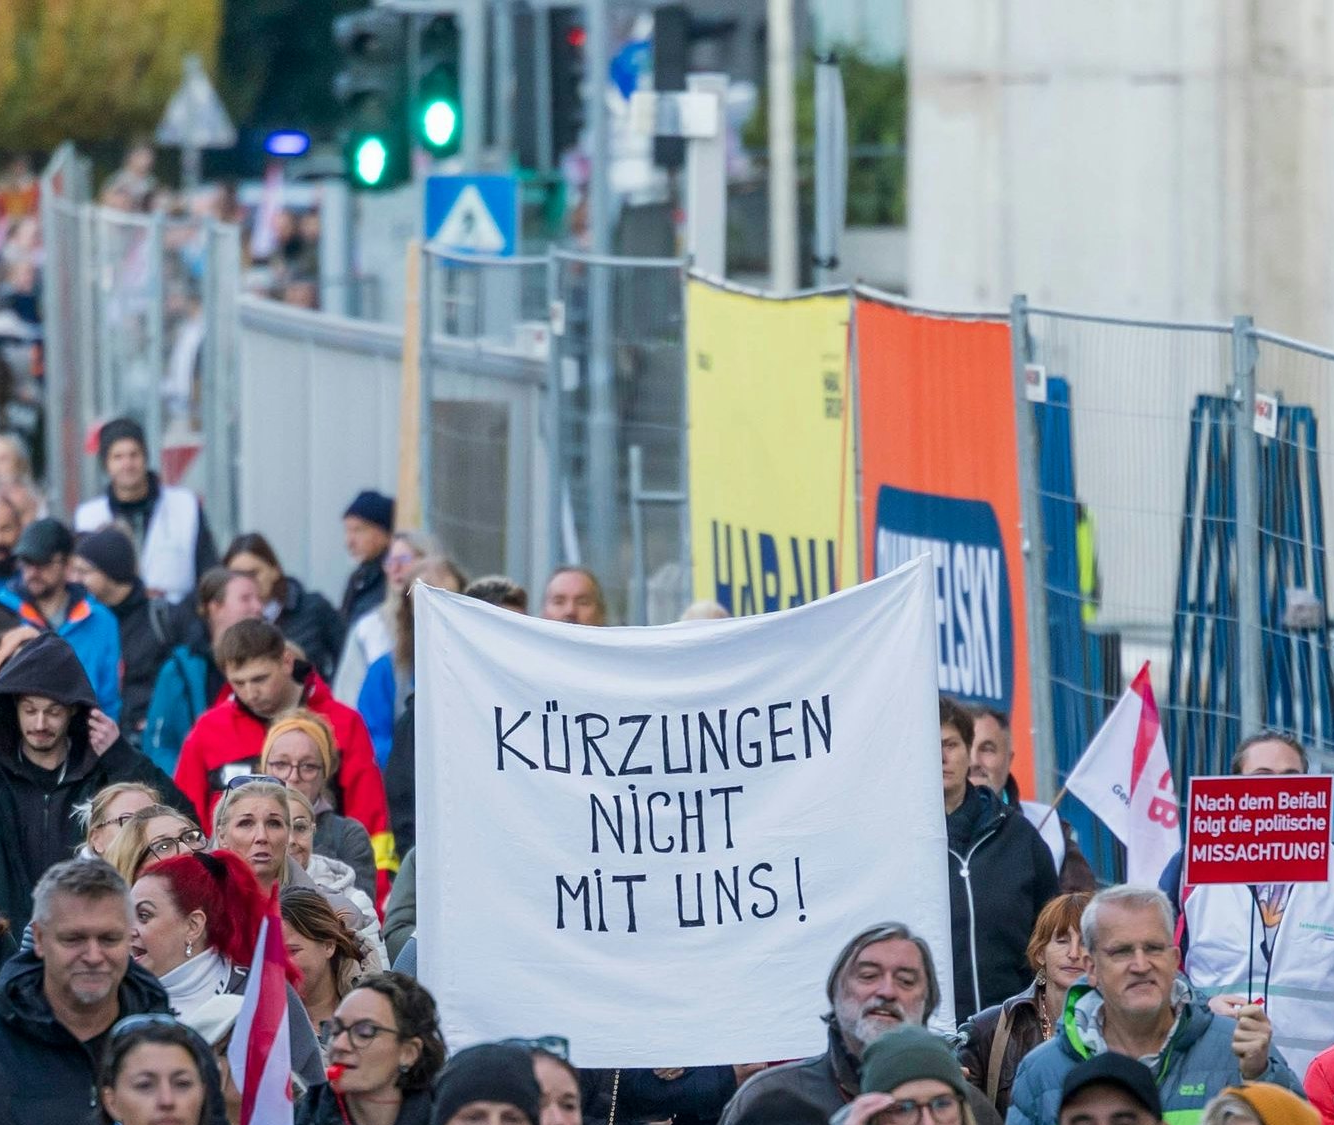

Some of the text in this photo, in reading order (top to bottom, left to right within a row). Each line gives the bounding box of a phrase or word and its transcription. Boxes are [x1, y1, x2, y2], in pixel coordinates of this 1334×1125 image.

[494, 694, 833, 777] KÜRZUNGEN
[589, 784, 744, 855] NICHT
[1194, 791, 1327, 812] Nach dem Beifall
[1193, 814, 1327, 837] folgt die politische
[1192, 842, 1326, 863] MISSACHTUNG!
[555, 857, 807, 933] MIT UNS!
